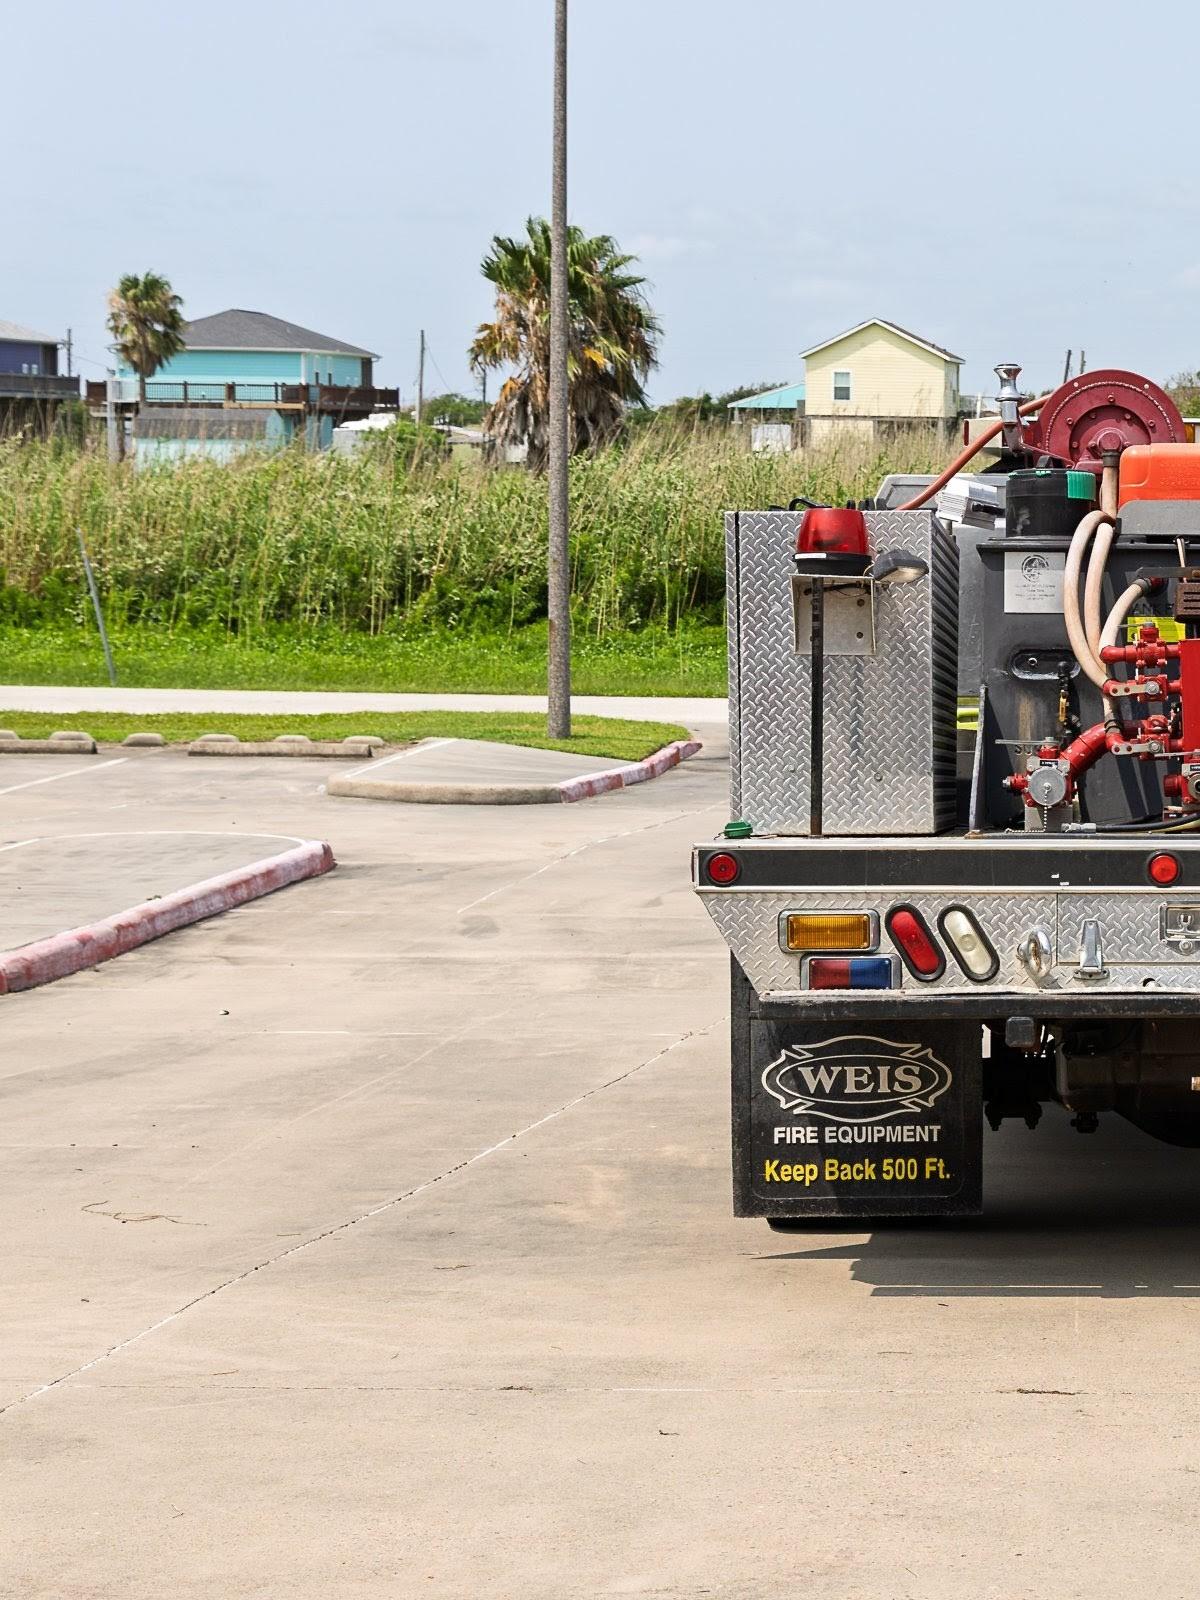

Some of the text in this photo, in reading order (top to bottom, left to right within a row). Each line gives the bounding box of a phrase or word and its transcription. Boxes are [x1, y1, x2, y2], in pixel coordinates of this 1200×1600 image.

[798, 1065, 922, 1094] WEIS
[773, 1125, 941, 1144] FIRE EQUIPMENT
[764, 1157, 951, 1187] Keep Back 500 Ft.
